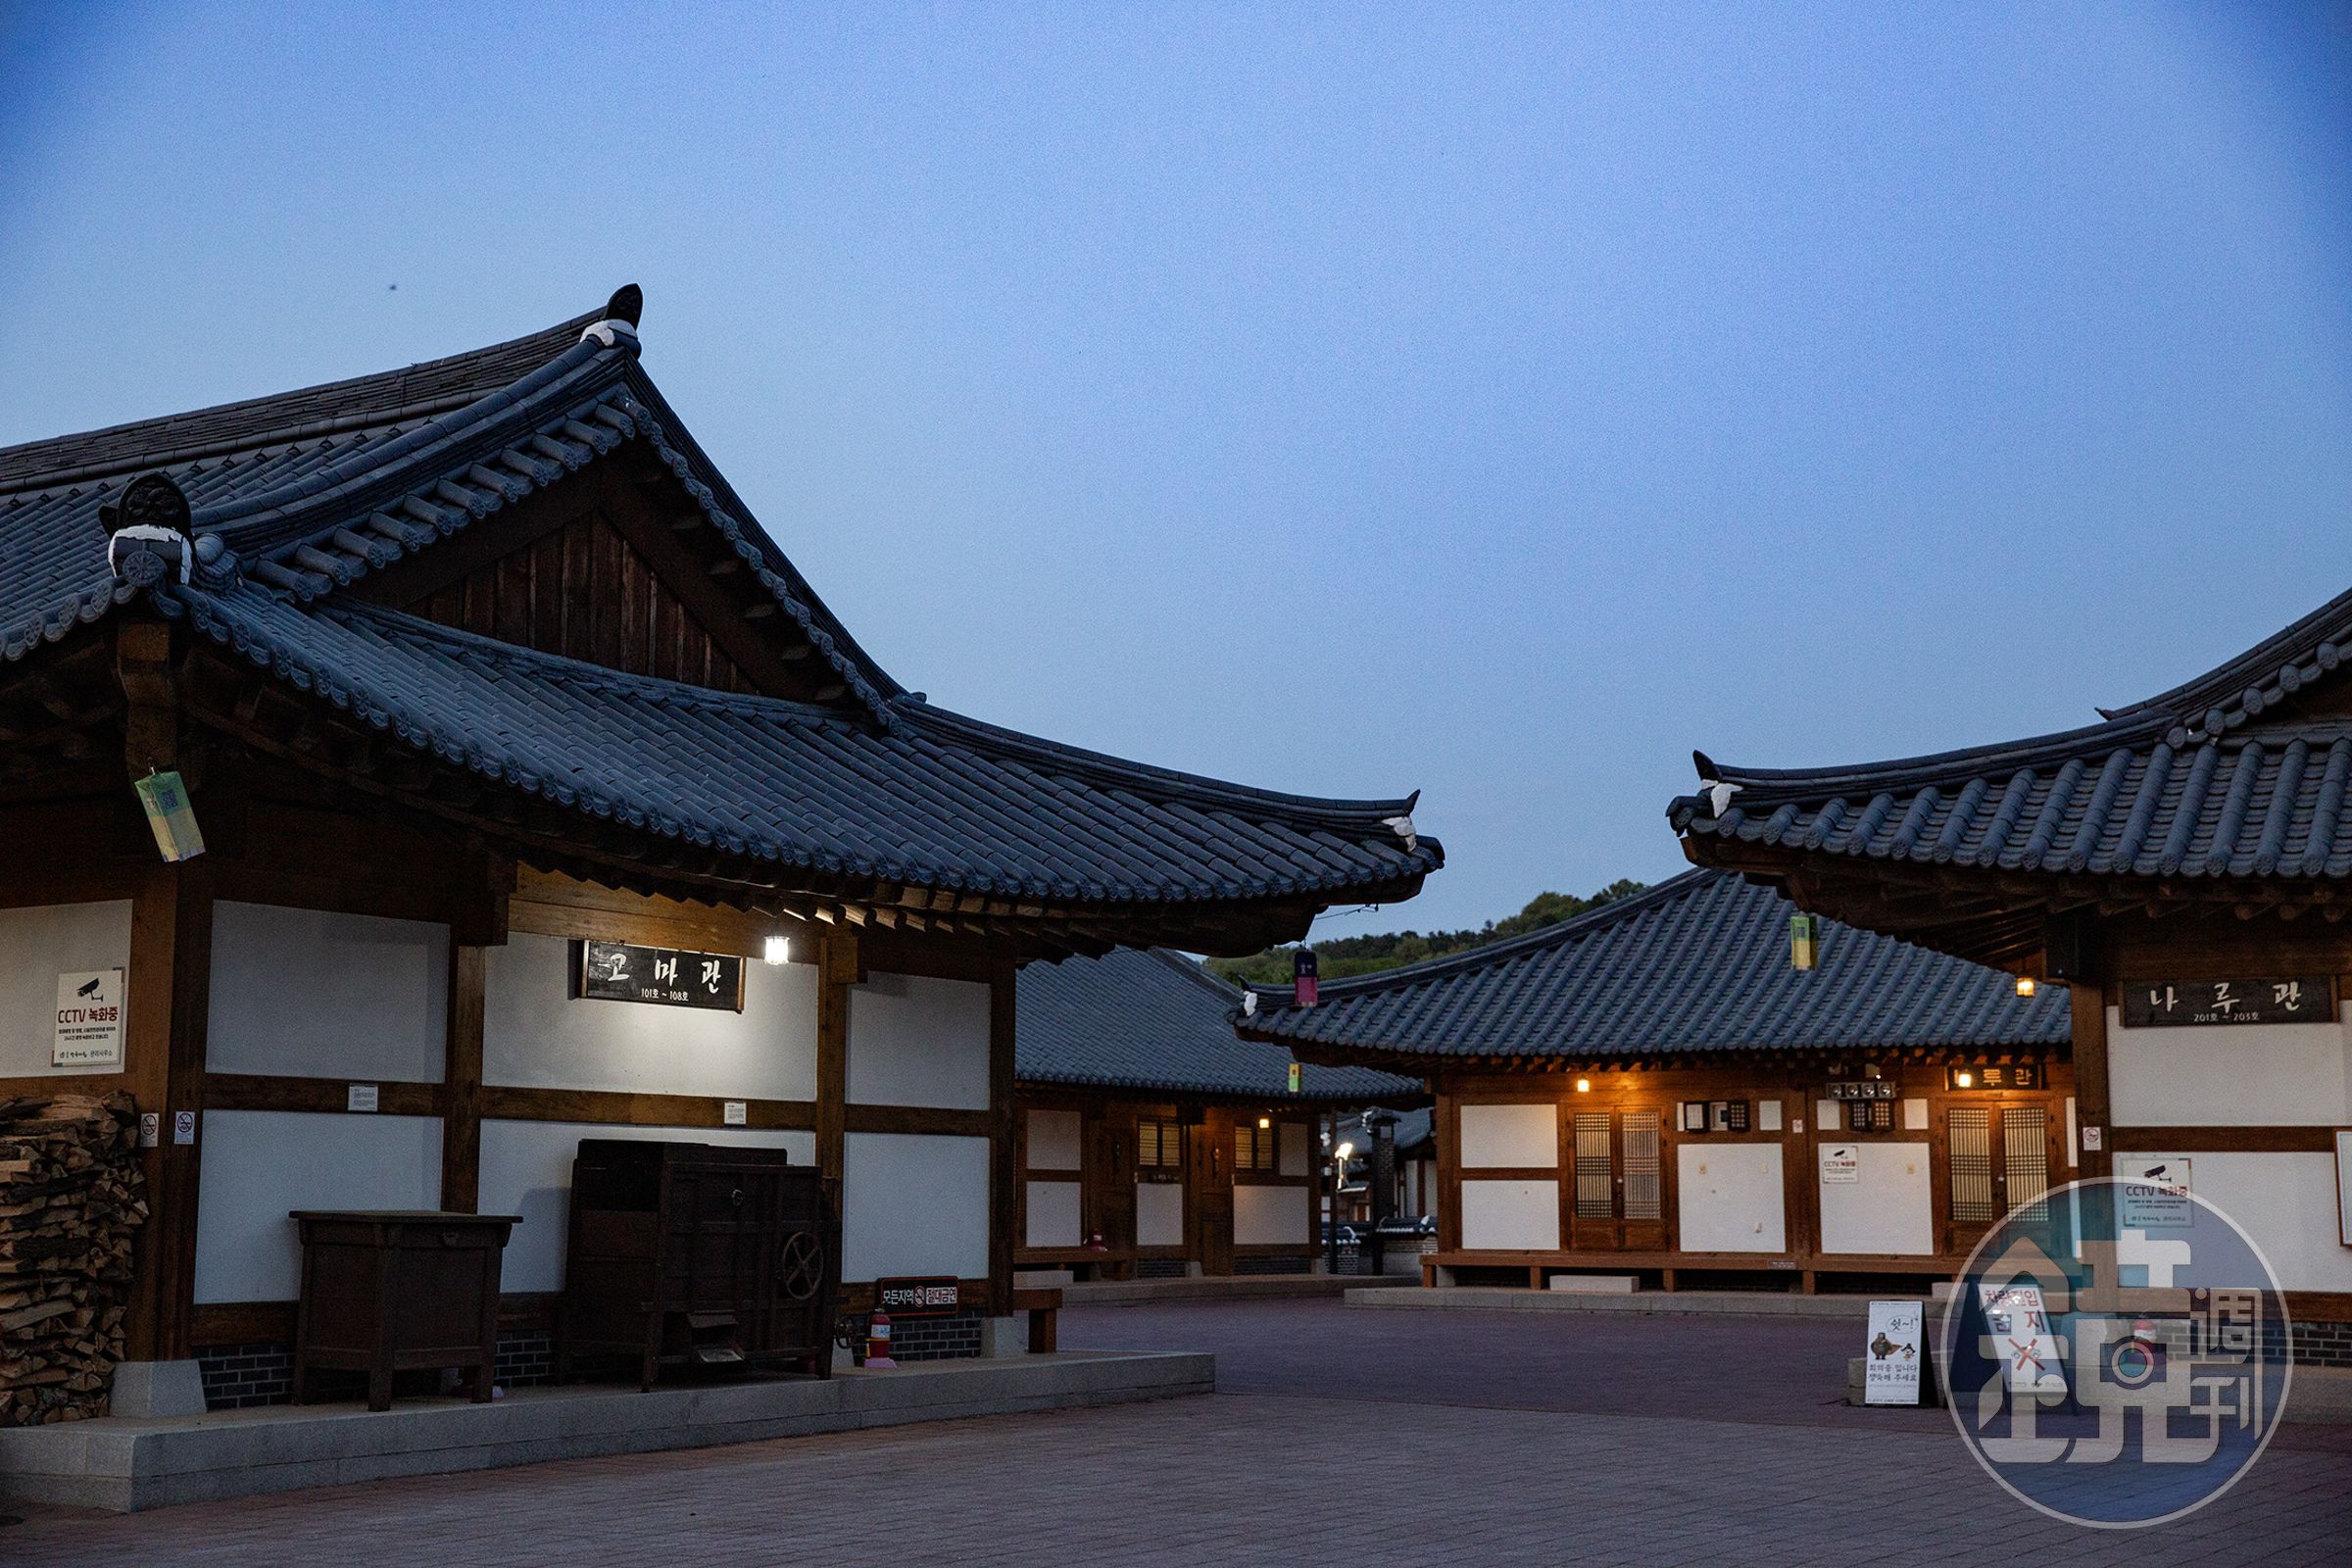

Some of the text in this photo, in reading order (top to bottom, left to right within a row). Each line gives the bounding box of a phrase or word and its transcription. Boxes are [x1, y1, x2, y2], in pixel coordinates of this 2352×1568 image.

[641, 988, 659, 999] 101호
[669, 990, 689, 1002] 108호
[58, 1006, 118, 1024] CCTV 녹화중
[2126, 1186, 2155, 1197] CCTV
[883, 1289, 914, 1305] 모든지역
